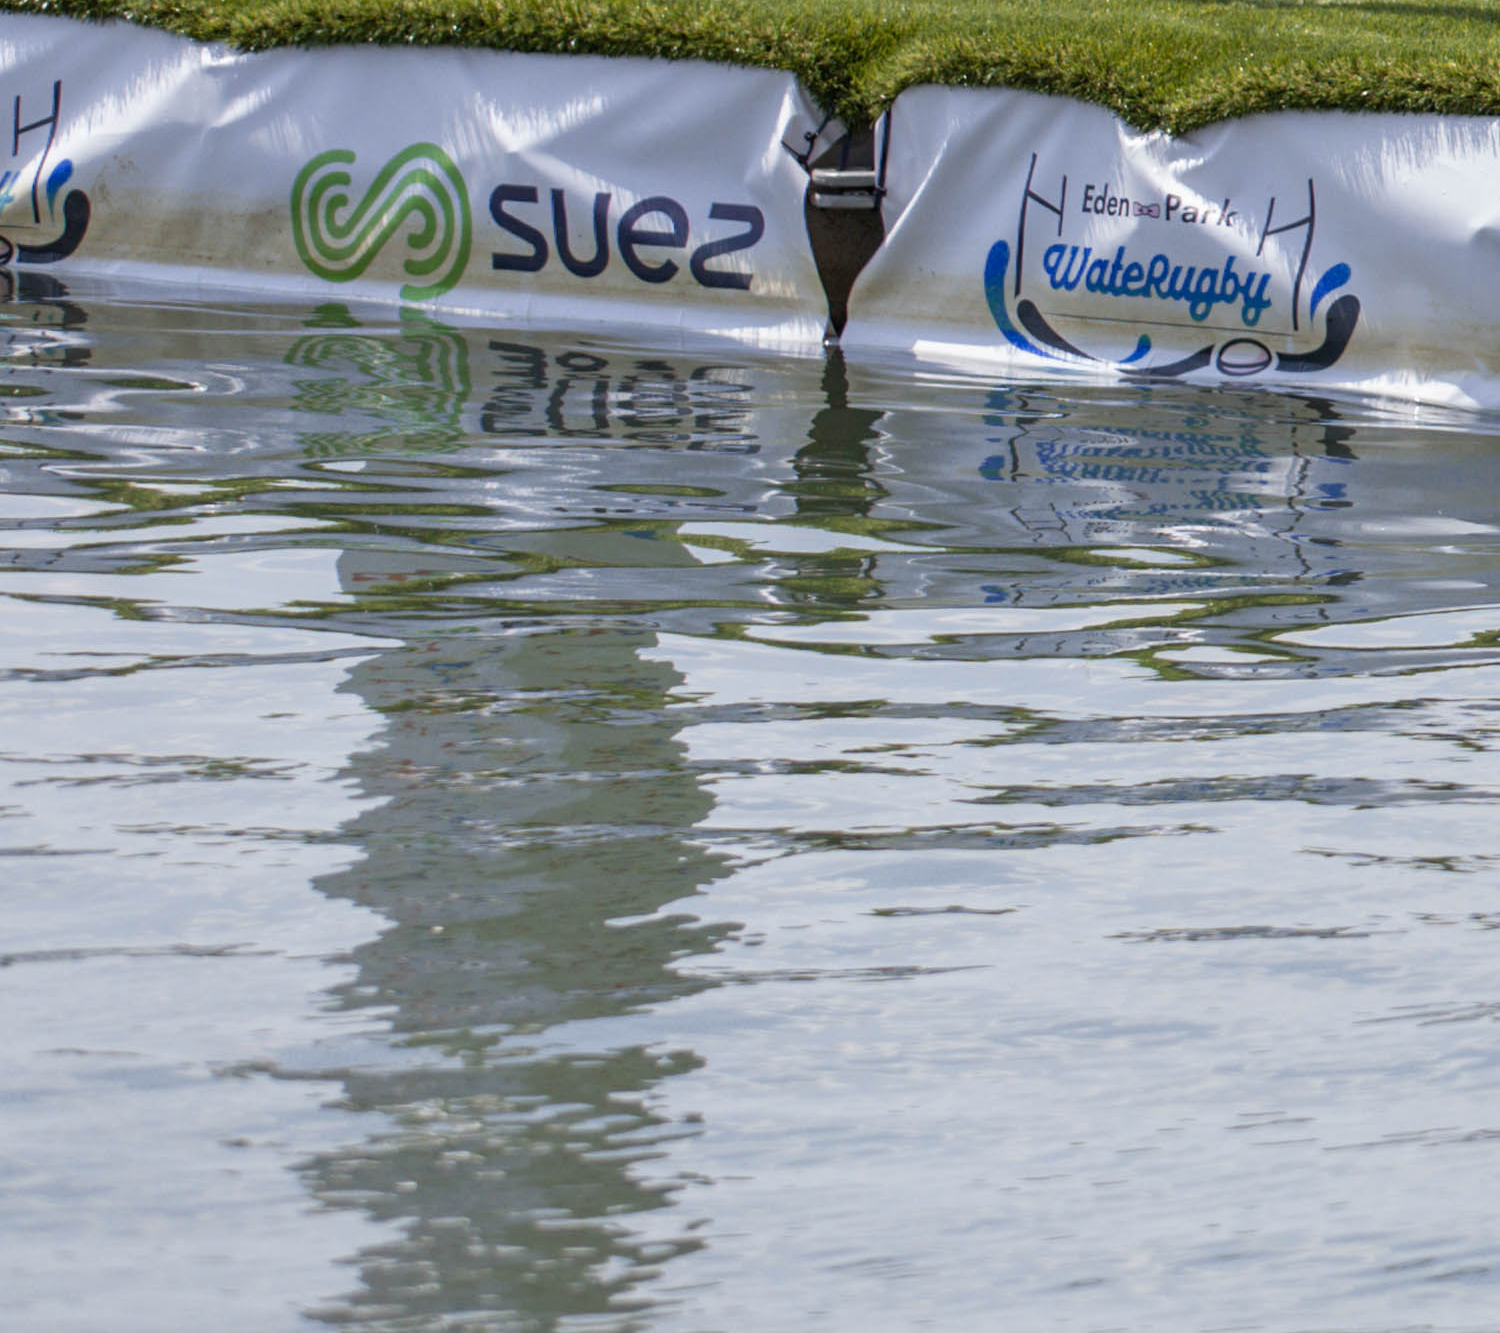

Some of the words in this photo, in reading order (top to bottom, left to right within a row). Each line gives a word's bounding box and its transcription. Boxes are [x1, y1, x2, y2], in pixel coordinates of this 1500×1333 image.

[1081, 183, 1130, 218] Eden
[1164, 193, 1238, 229] Park
[1042, 243, 1272, 327] WateRugby
